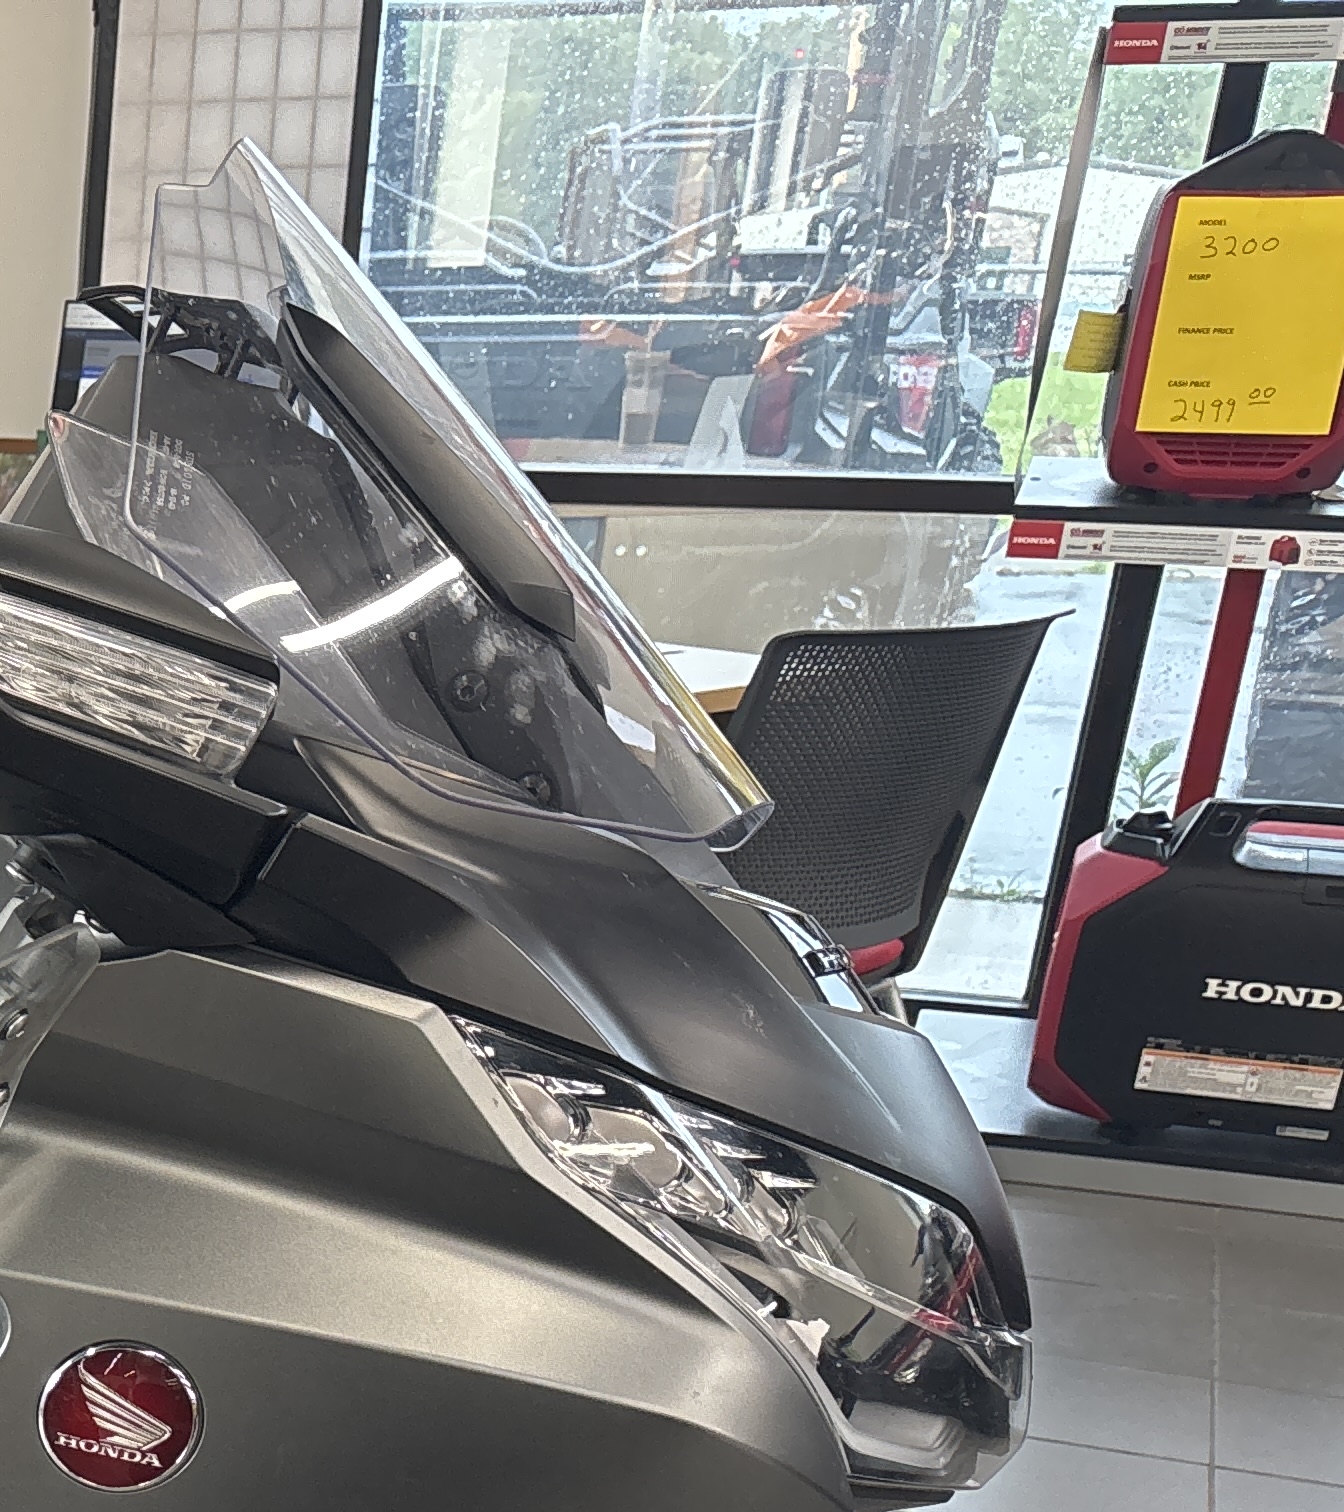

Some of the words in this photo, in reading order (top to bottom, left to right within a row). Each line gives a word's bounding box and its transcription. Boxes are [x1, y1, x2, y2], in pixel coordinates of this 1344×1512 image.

[1113, 38, 1159, 48] HONDA
[1199, 235, 1280, 259] 3200
[1212, 327, 1235, 335] PRICE
[1189, 380, 1211, 388] PRICE
[1169, 398, 1236, 423] 2499
[1012, 536, 1057, 546] HONDA
[53, 1431, 164, 1468] HONDA
